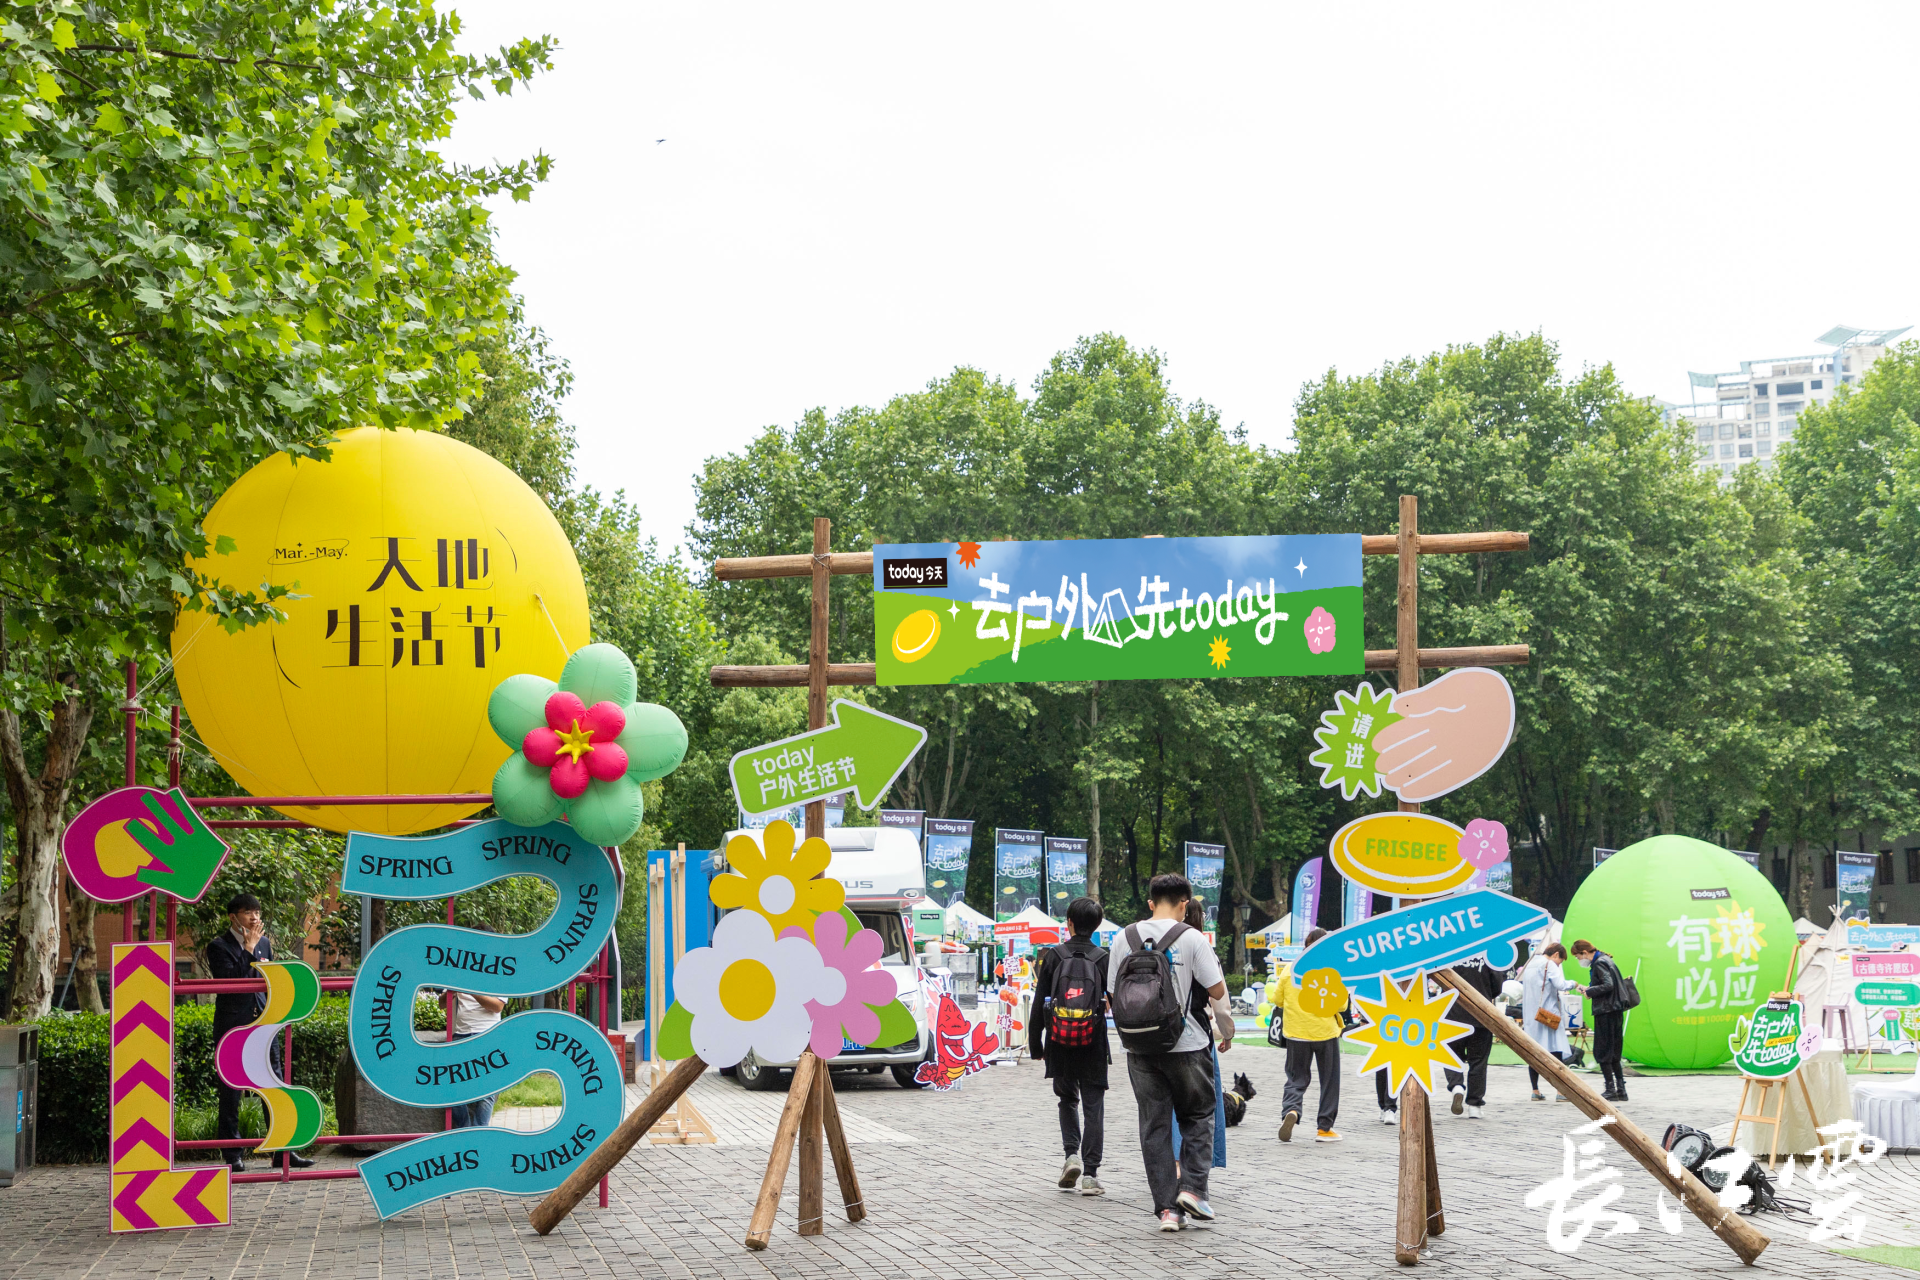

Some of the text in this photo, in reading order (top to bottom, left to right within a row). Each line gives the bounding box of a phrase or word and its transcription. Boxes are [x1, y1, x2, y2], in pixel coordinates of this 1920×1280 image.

[366, 537, 494, 592] 天地
[888, 563, 943, 584] today 今天
[322, 602, 508, 668] 生活节
[752, 745, 814, 776] today
[759, 756, 857, 806] 户外生活节
[882, 814, 905, 824] today
[935, 823, 957, 833] today
[1003, 832, 1025, 842] today
[481, 832, 573, 867] SPRING
[1053, 842, 1072, 850] today
[1365, 838, 1447, 862] FRISBEE
[359, 854, 454, 879] SPRING
[1691, 890, 1716, 899] today
[543, 883, 599, 965] SPRING
[1343, 906, 1484, 963] SURFSKATE
[1666, 910, 1761, 963] 有球
[425, 945, 517, 976] SPRING
[1676, 961, 1760, 1011] 必应
[370, 965, 402, 1060] SPRING
[1753, 1013, 1796, 1045] 去户外
[1378, 1013, 1440, 1051] GO!
[415, 1048, 510, 1086] SPRING
[536, 1030, 604, 1097] SPRING
[510, 1123, 597, 1174] SPRING
[385, 1149, 479, 1193] SPRING
